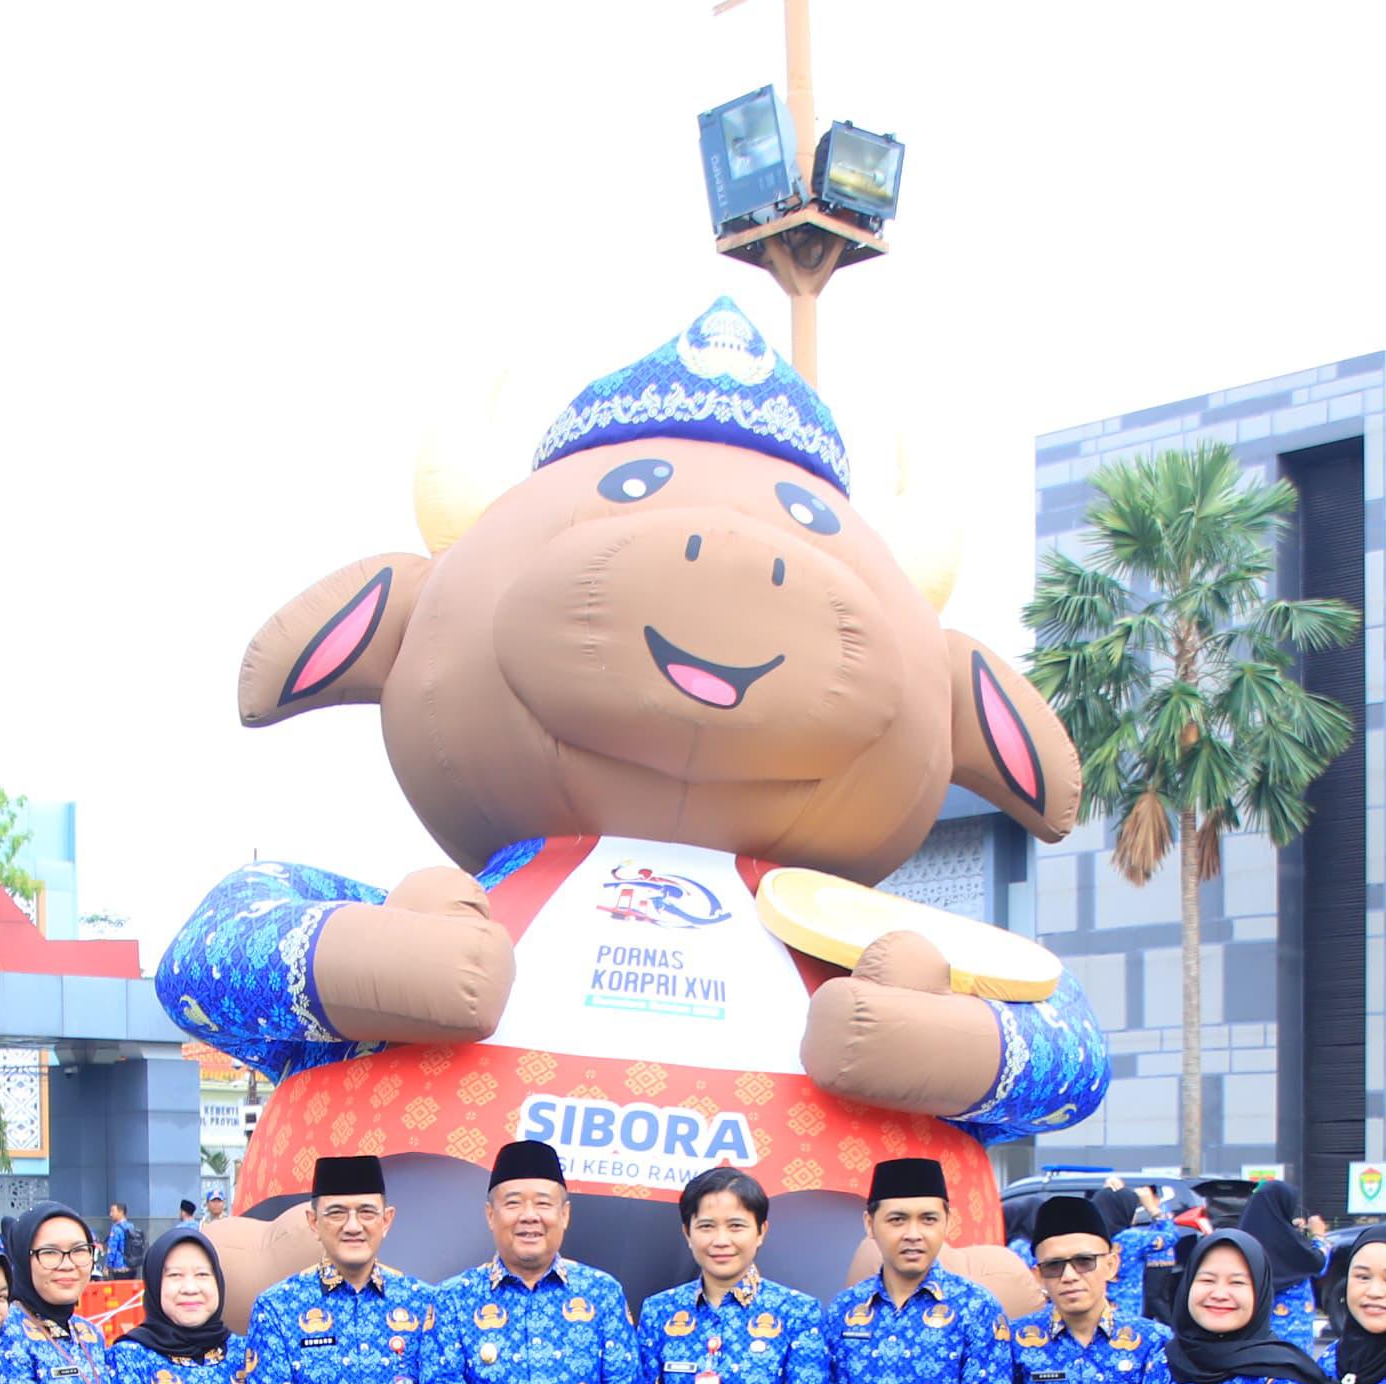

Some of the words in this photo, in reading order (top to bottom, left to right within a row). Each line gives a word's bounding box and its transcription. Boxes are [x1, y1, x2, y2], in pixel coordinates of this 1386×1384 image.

[596, 944, 684, 970] PORNAS
[590, 969, 677, 997] KORPRI
[684, 976, 726, 1002] XVII
[524, 1101, 750, 1160] SIBORA
[583, 1158, 640, 1179] KEBO
[648, 1164, 699, 1184] RAW
